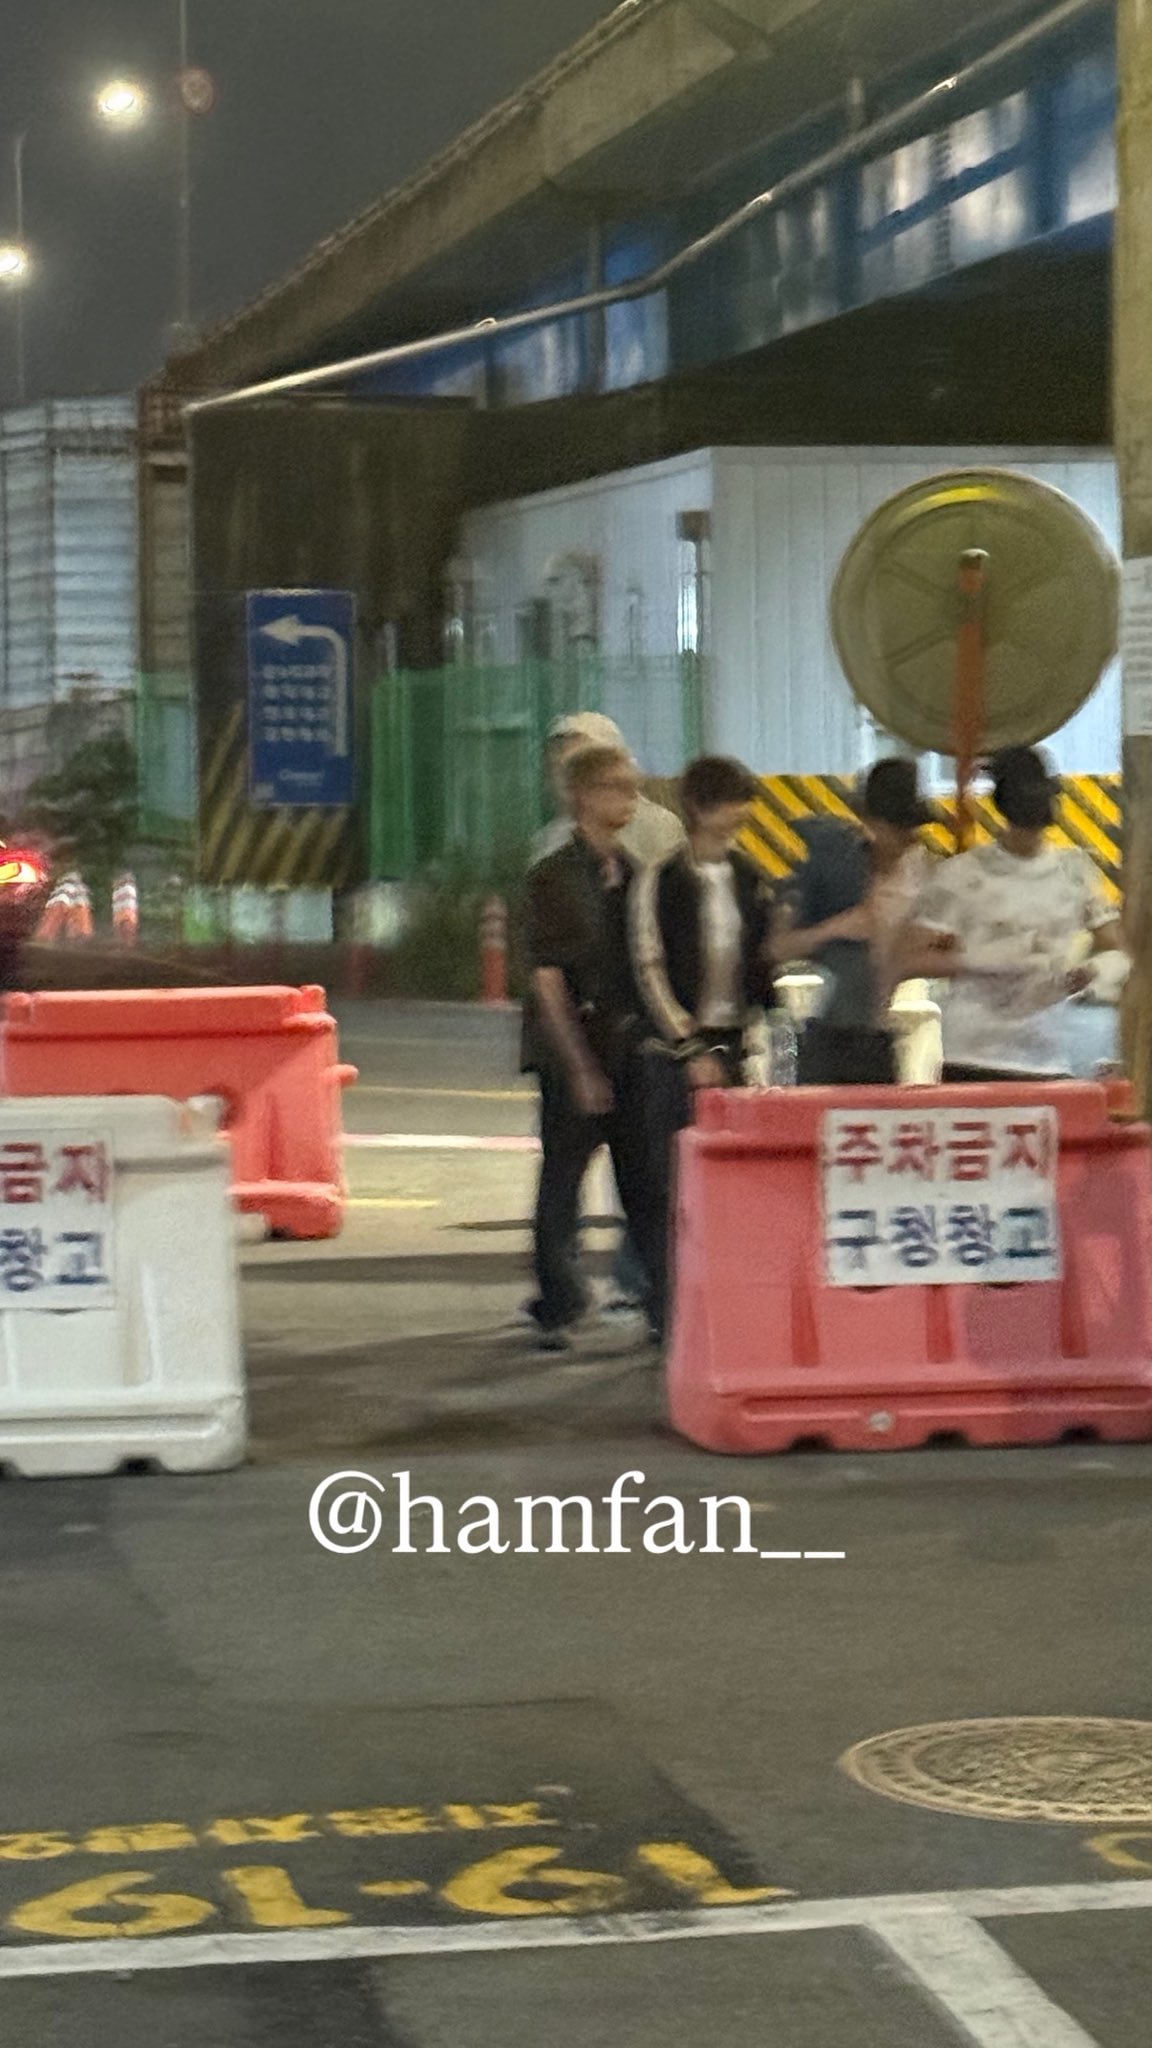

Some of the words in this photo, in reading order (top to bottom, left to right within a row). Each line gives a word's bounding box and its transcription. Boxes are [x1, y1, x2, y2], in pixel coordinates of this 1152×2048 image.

[0, 1142, 107, 1203] 금지
[830, 1119, 1051, 1184] 주차금지
[0, 1227, 108, 1292] 창고
[830, 1204, 1054, 1268] 구청창고
[5, 1841, 797, 1938] 19-19
